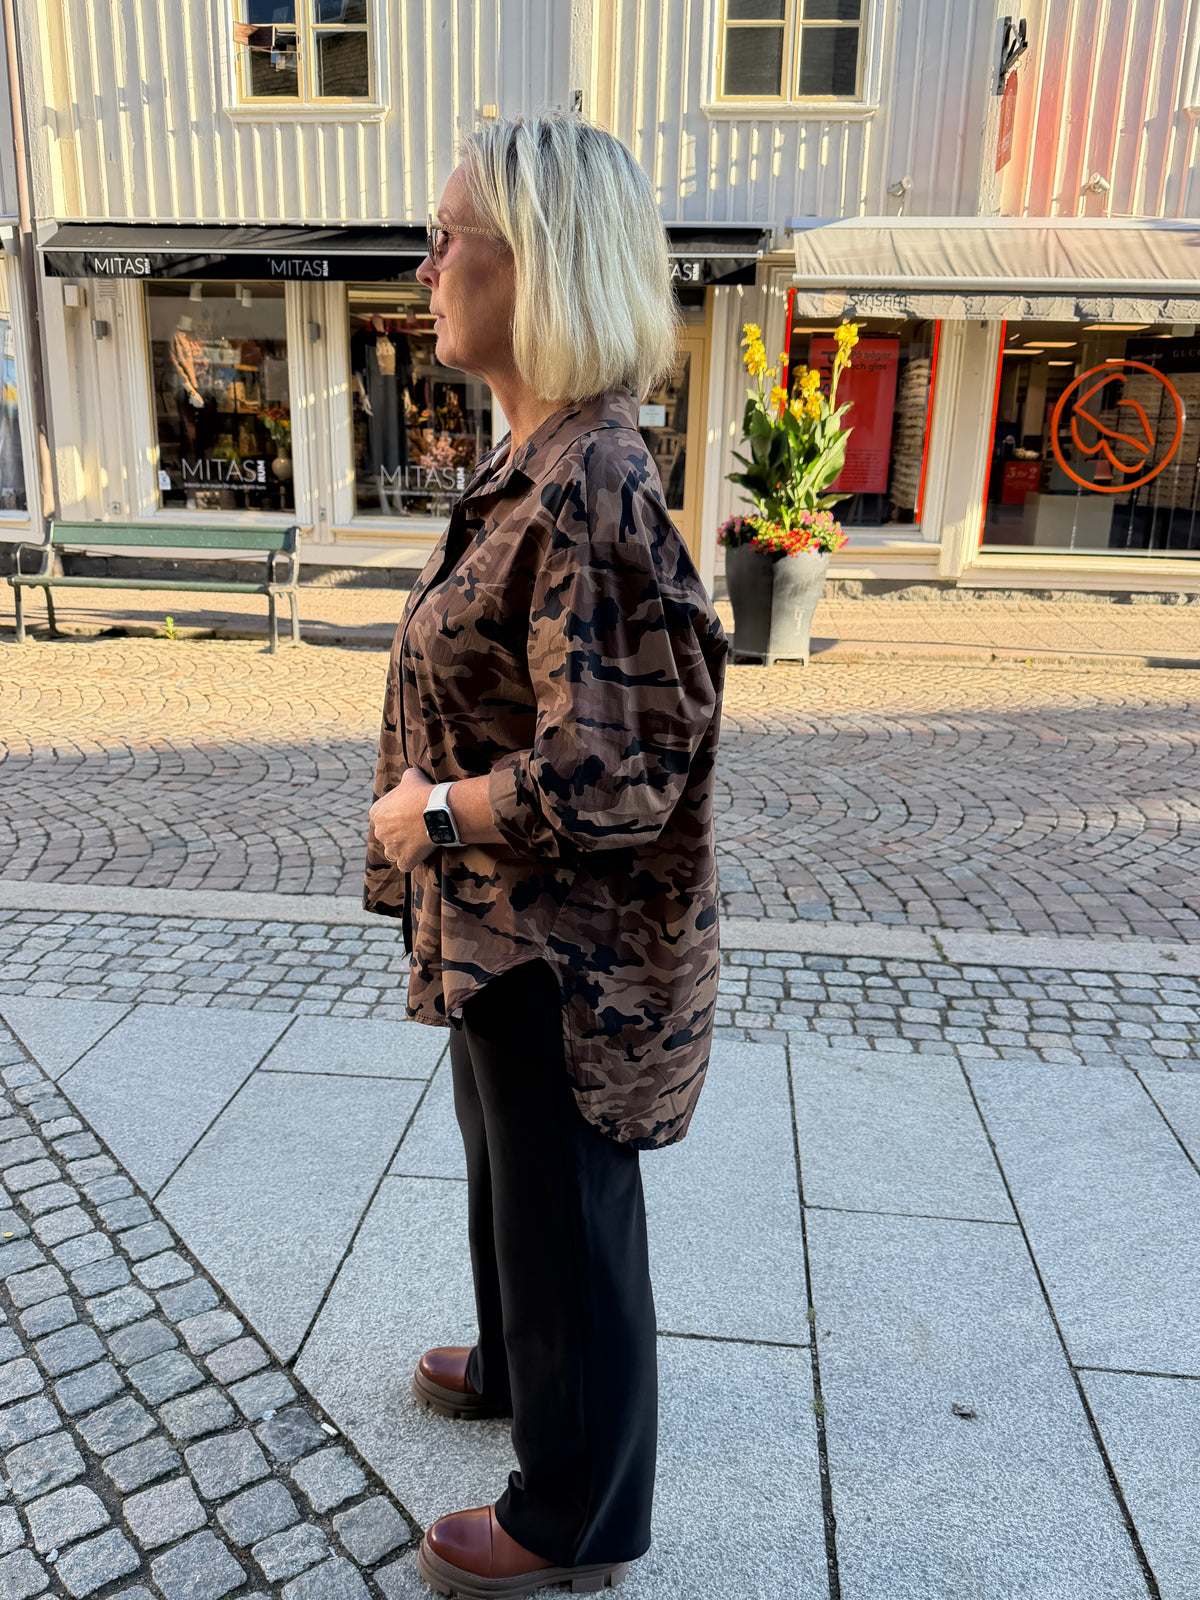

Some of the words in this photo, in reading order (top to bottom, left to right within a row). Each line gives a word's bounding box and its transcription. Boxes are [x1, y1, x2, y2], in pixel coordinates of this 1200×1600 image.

[94, 257, 145, 274] MITAS
[271, 259, 323, 277] MITAS
[868, 362, 887, 372] glas
[181, 458, 257, 482] MITAS
[256, 460, 266, 482] RUM
[380, 464, 456, 490] MITAS
[456, 466, 465, 490] RUM
